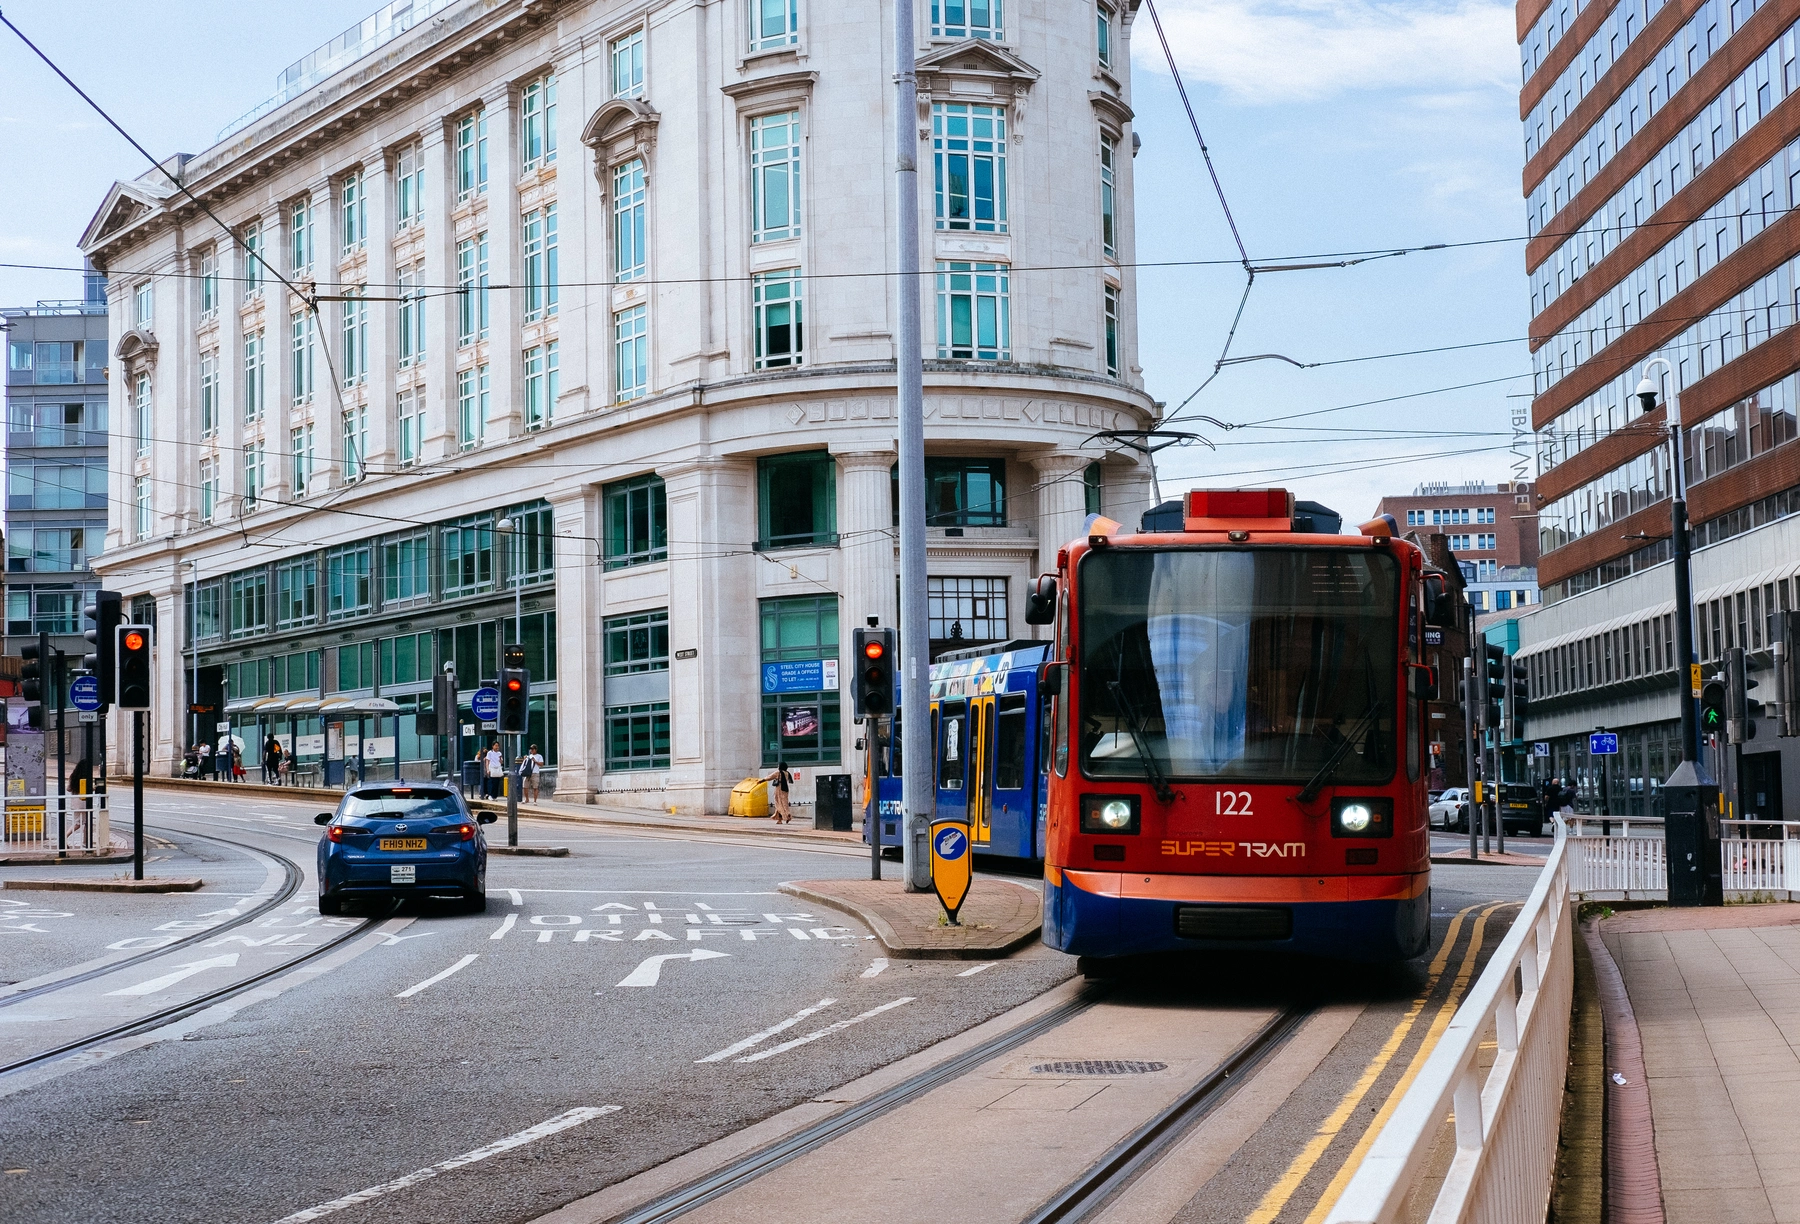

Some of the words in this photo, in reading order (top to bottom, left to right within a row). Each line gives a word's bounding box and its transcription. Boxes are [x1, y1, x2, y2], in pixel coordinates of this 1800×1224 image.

[81, 712, 94, 720] only
[1216, 791, 1253, 815] 122
[383, 840, 403, 848] FH19
[406, 840, 423, 848] NHZ
[1161, 840, 1235, 857] SUPER
[591, 902, 748, 911] ALL
[529, 913, 823, 925] OTHER
[522, 927, 857, 942] TRAFFIC
